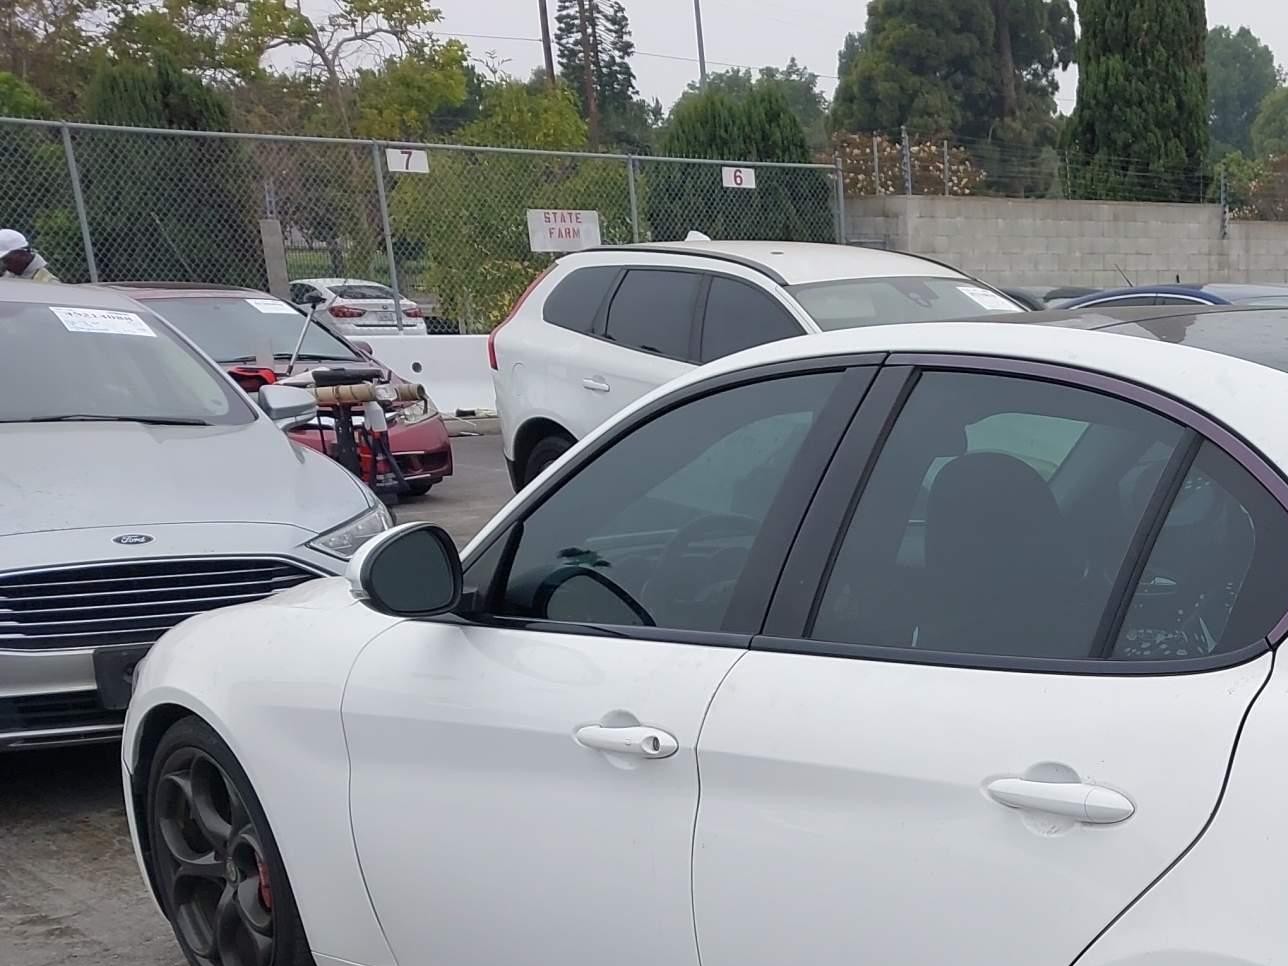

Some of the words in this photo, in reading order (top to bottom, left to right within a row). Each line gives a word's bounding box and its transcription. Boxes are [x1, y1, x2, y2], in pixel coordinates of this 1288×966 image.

[402, 150, 413, 170] 7
[733, 168, 744, 186] 6
[543, 212, 583, 224] STATE
[548, 227, 581, 239] FARM
